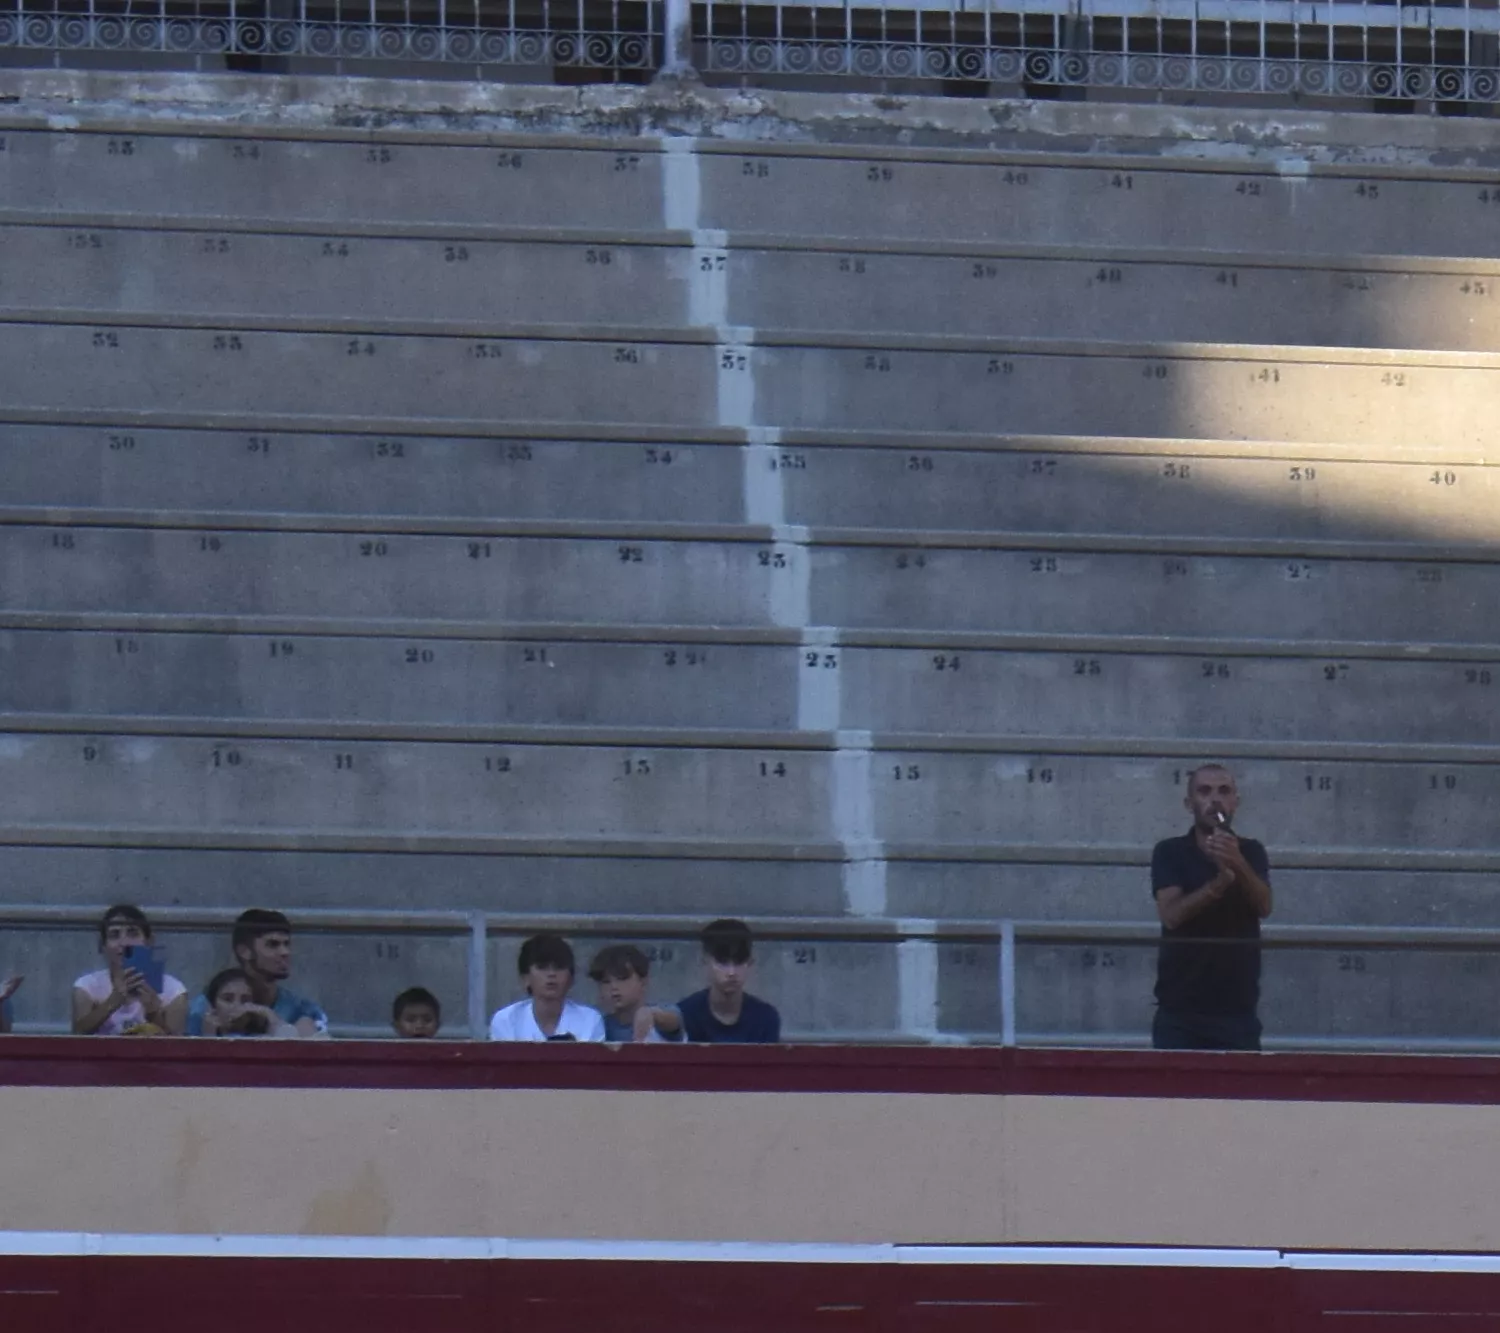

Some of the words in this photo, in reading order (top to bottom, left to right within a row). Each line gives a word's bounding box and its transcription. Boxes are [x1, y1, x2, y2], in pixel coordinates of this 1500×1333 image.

[1003, 171, 1028, 185] 40
[1111, 175, 1132, 189] 41
[1235, 181, 1260, 196] 42
[1215, 270, 1237, 287] 41
[1259, 368, 1279, 383] 41
[1429, 472, 1456, 485] 40
[360, 541, 387, 556] 20
[618, 547, 642, 562] 22
[270, 642, 294, 657] 19
[523, 647, 547, 662] 21
[933, 656, 960, 671] 24
[1202, 662, 1230, 678] 26
[83, 746, 96, 760] 9
[210, 751, 242, 766] 10
[336, 754, 352, 769] 11
[485, 757, 511, 772] 12
[760, 762, 786, 777] 14
[1027, 767, 1053, 783] 16
[1305, 776, 1331, 790] 18
